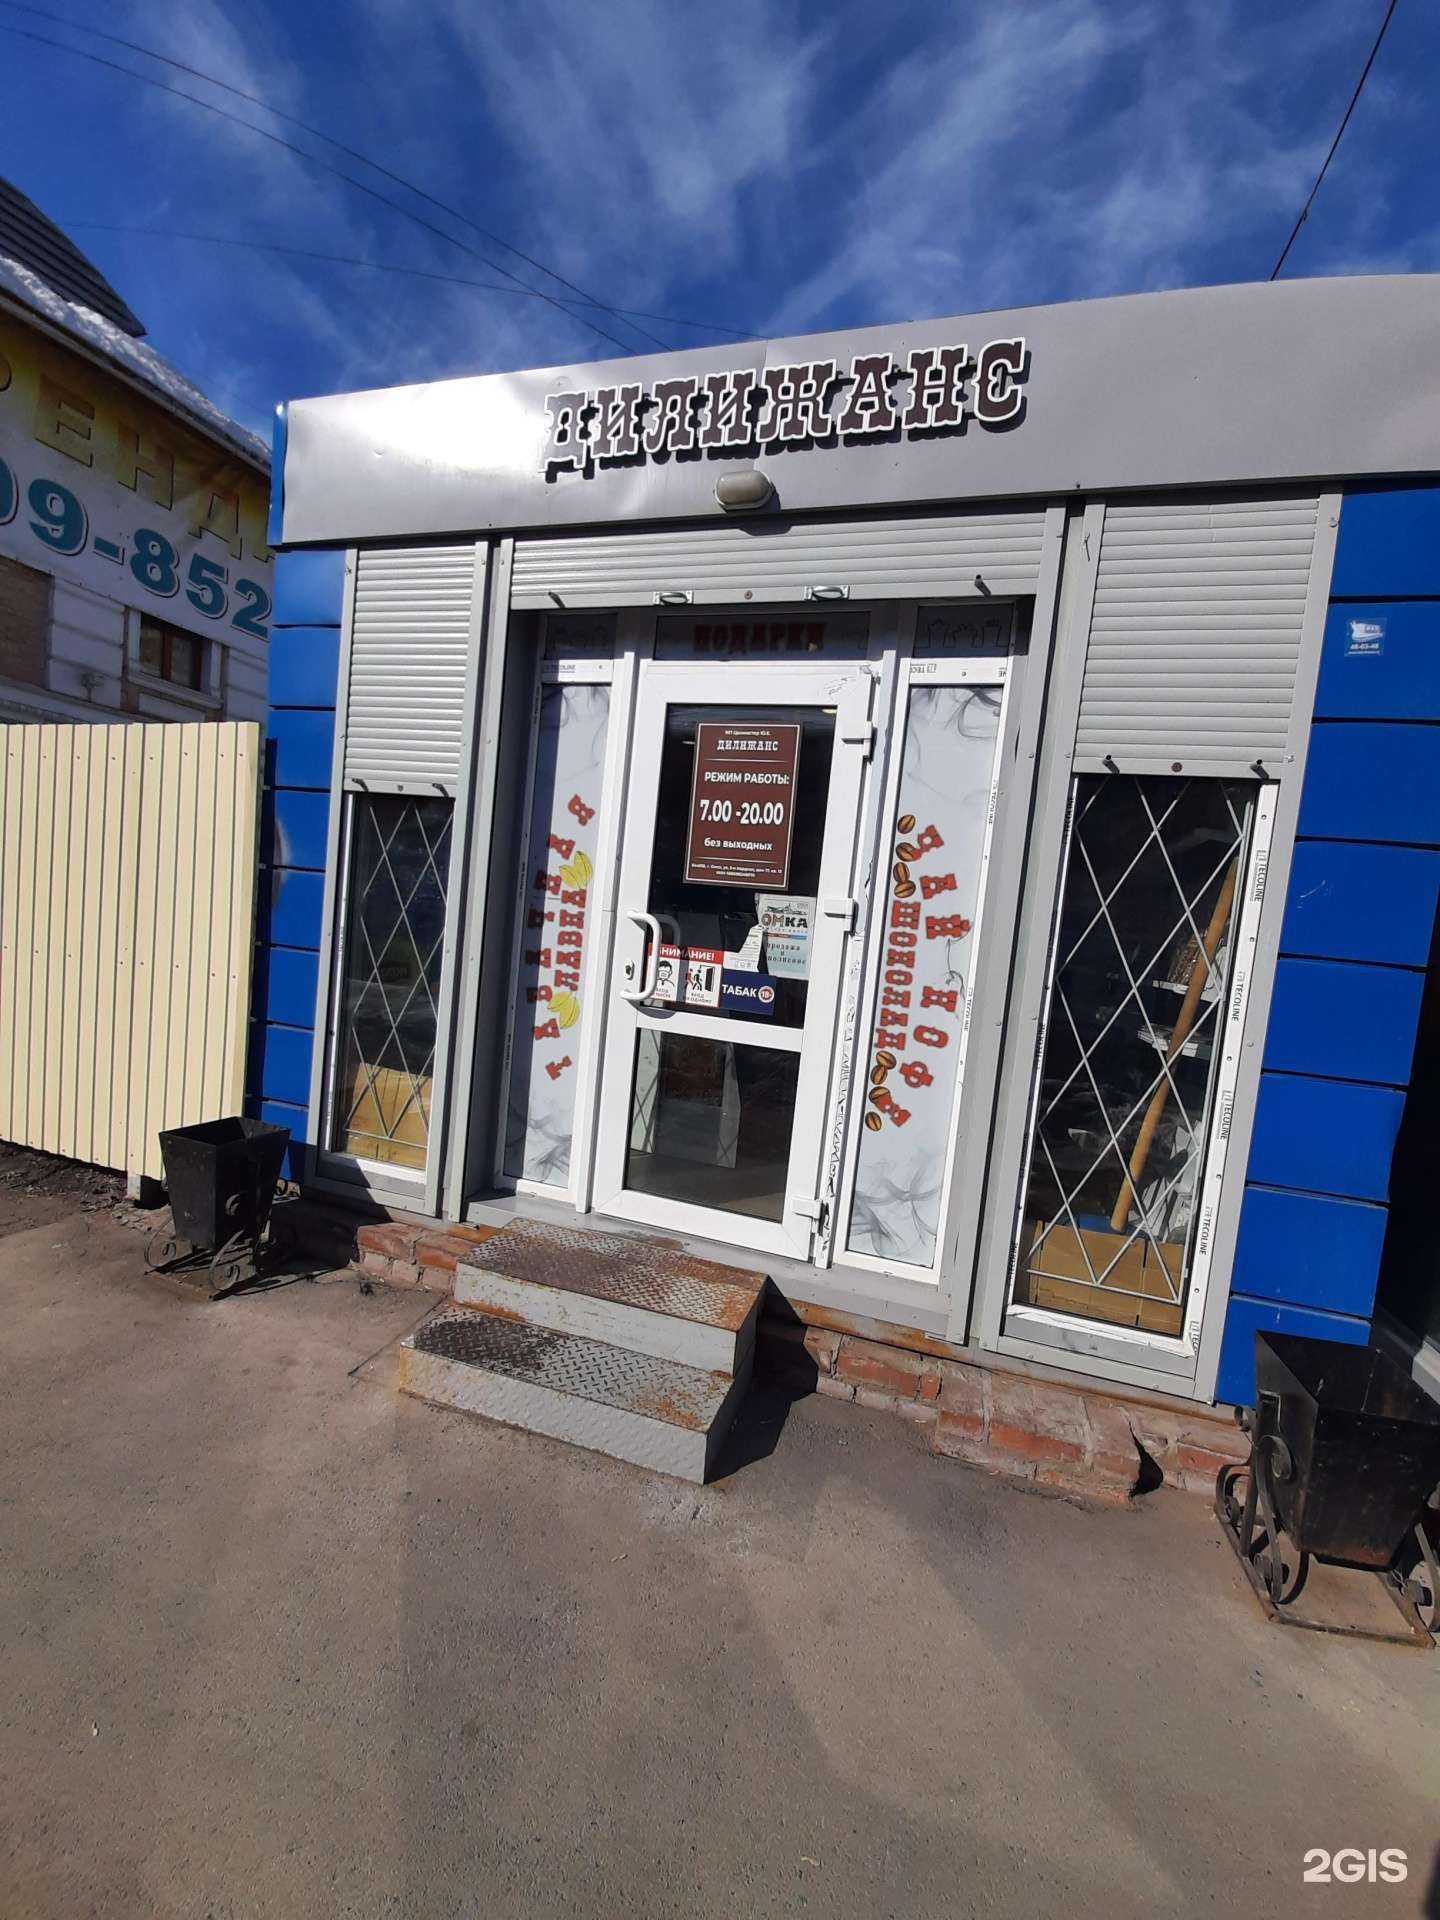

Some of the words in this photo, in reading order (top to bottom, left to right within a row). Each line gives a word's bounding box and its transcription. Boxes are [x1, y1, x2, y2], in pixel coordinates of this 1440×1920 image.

[537, 337, 1026, 475] ДИЛИЖАНС
[717, 740, 779, 751] ДИЛИЖАНС
[704, 771, 742, 783] РЕЖИМ
[743, 773, 790, 785] РАБОТЫ:
[700, 799, 732, 822] 7.00
[704, 837, 721, 848] без
[723, 840, 773, 851] выходных
[1254, 862, 1268, 902] TECOLINE
[761, 913, 808, 928] ОМКА
[660, 946, 715, 961] НИМАНИЕ!
[874, 900, 921, 1050] ШОКОЛАД
[721, 984, 757, 998] ТАБАК
[1232, 982, 1244, 1022] TECOLINE
[1220, 1103, 1232, 1140] TECOLINE
[1199, 1217, 1211, 1255] TECOLINE
